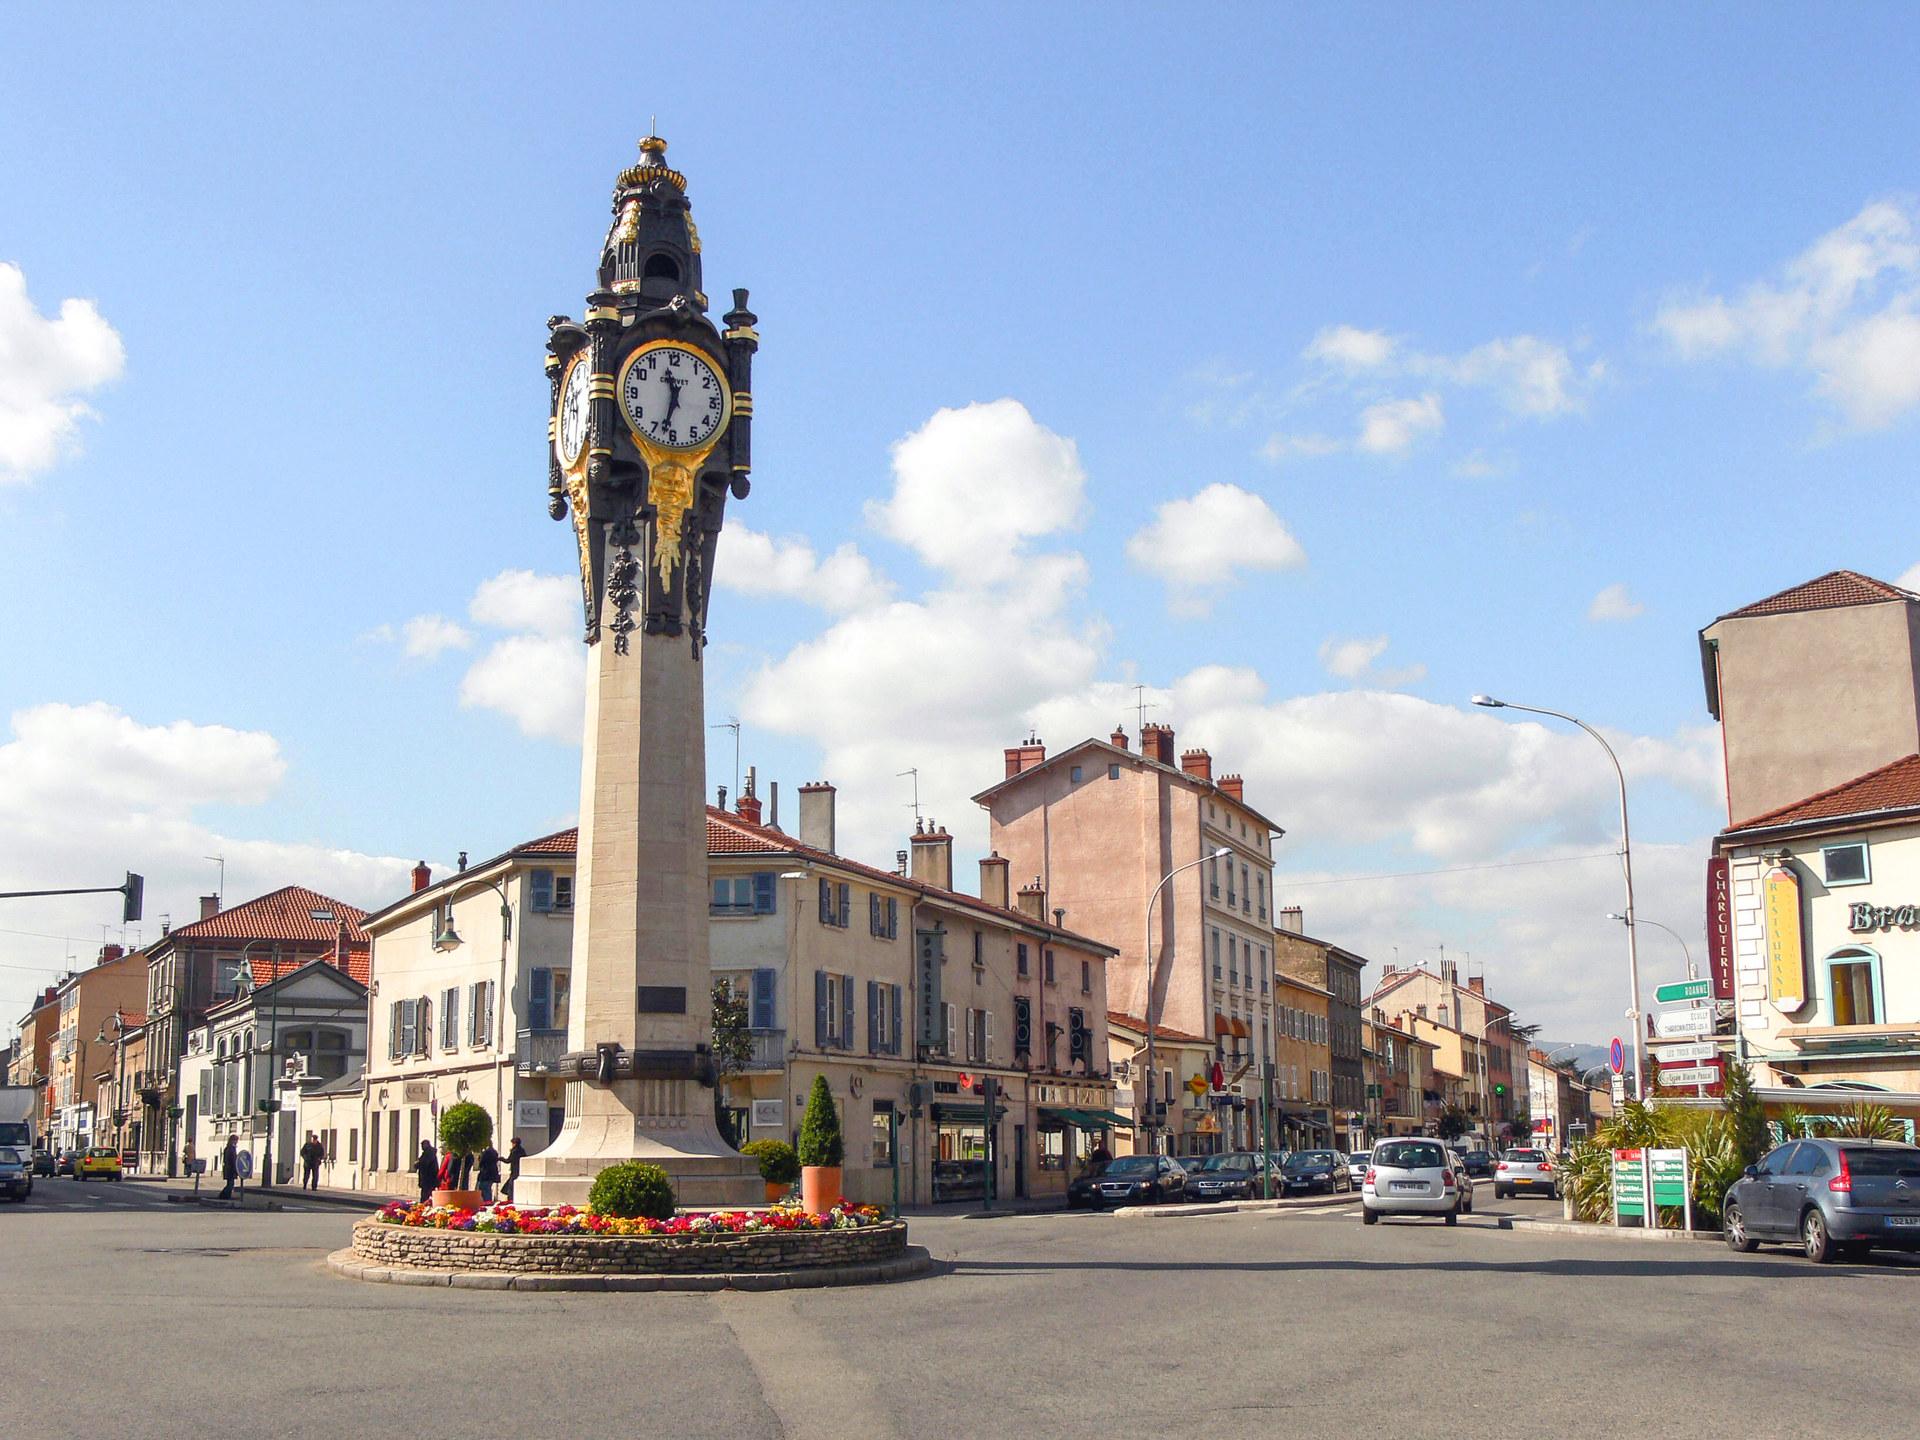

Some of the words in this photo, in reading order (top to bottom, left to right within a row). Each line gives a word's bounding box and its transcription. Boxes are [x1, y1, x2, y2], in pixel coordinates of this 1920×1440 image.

[648, 355, 656, 369] 11
[669, 354, 680, 367] 12
[635, 367, 647, 381] 10
[702, 377, 711, 389] 2
[630, 387, 638, 399] 9
[709, 397, 717, 409] 3
[635, 406, 643, 418] 8
[651, 421, 659, 433] 7
[702, 415, 710, 427] 4
[669, 430, 677, 442] 6
[690, 426, 698, 438] 5
[1848, 902, 1920, 931] Bra
[1716, 869, 1729, 989] CHARCUTERIE
[1684, 983, 1708, 996] ROANNE
